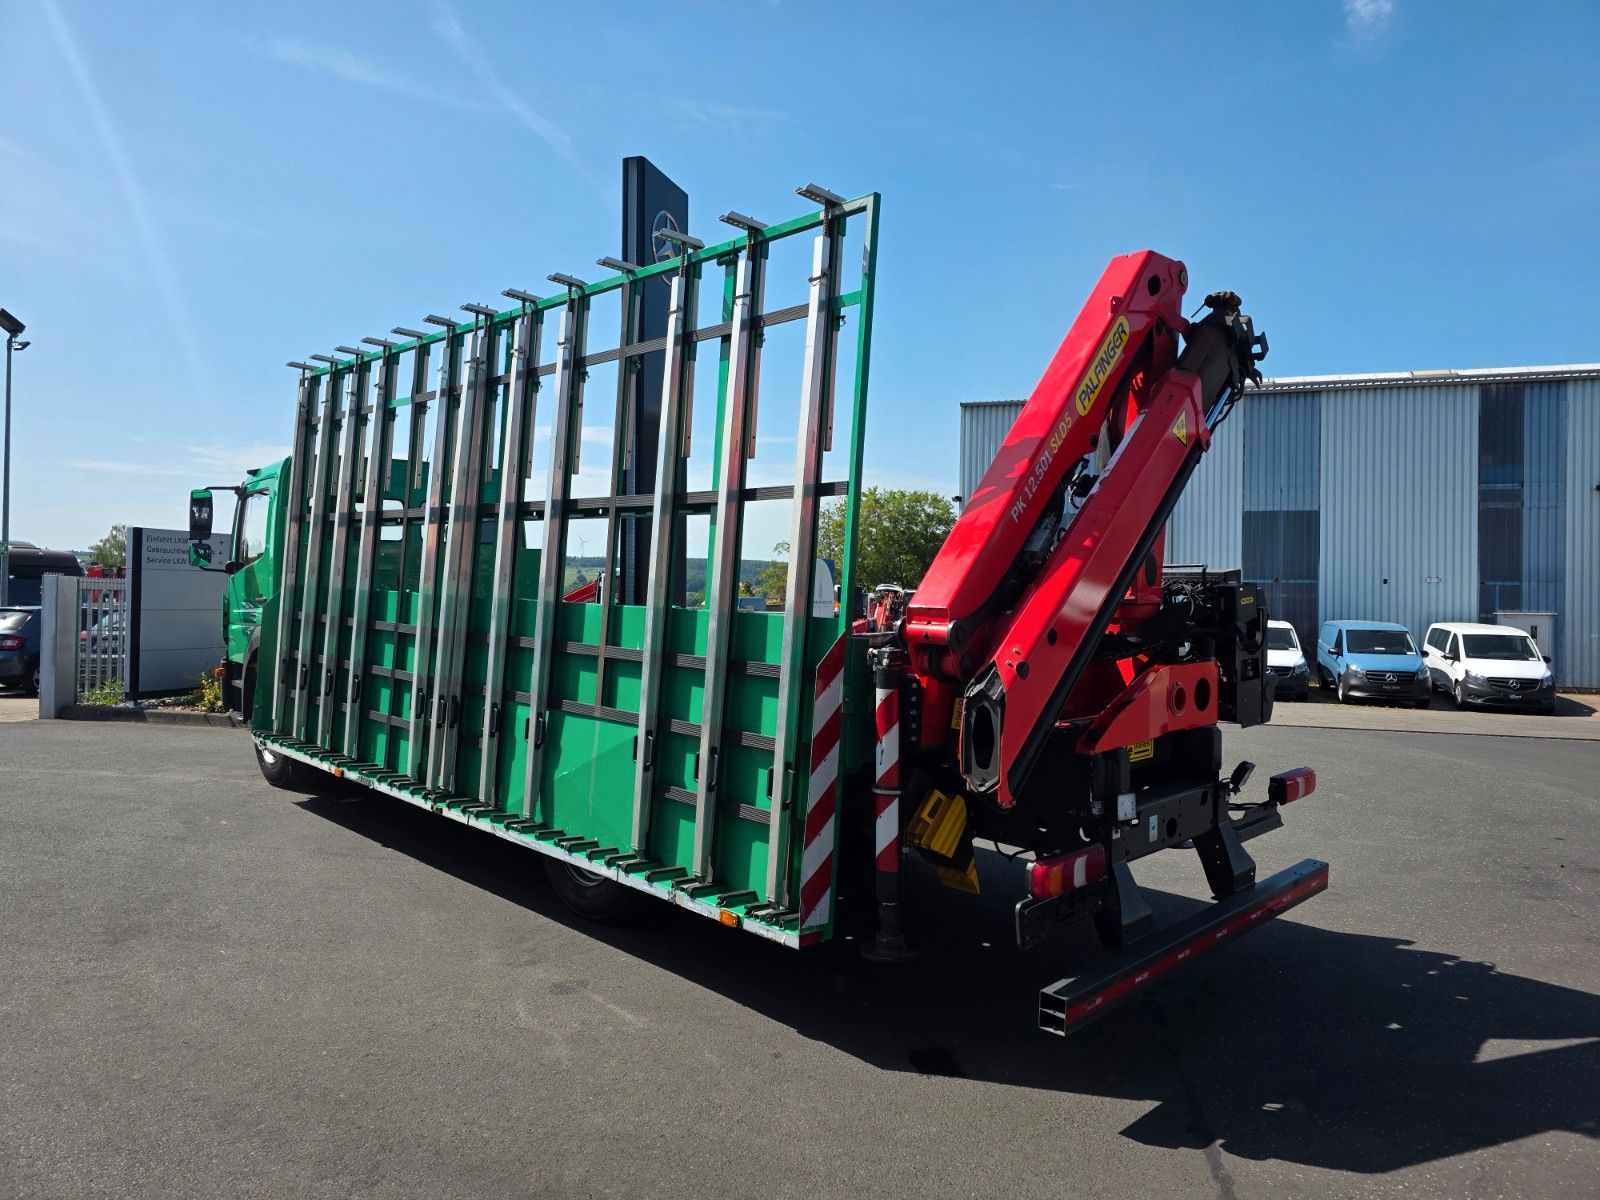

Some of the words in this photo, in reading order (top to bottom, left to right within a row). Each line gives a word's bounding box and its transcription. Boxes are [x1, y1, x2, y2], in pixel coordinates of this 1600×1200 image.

[1078, 322, 1127, 411] PALFINGER
[1011, 496, 1027, 523] PK
[1024, 451, 1053, 500] 12.501
[1050, 412, 1073, 454] SLD5
[146, 535, 173, 543] Einfahrt
[146, 556, 171, 564] Service
[172, 557, 187, 565] LKW
